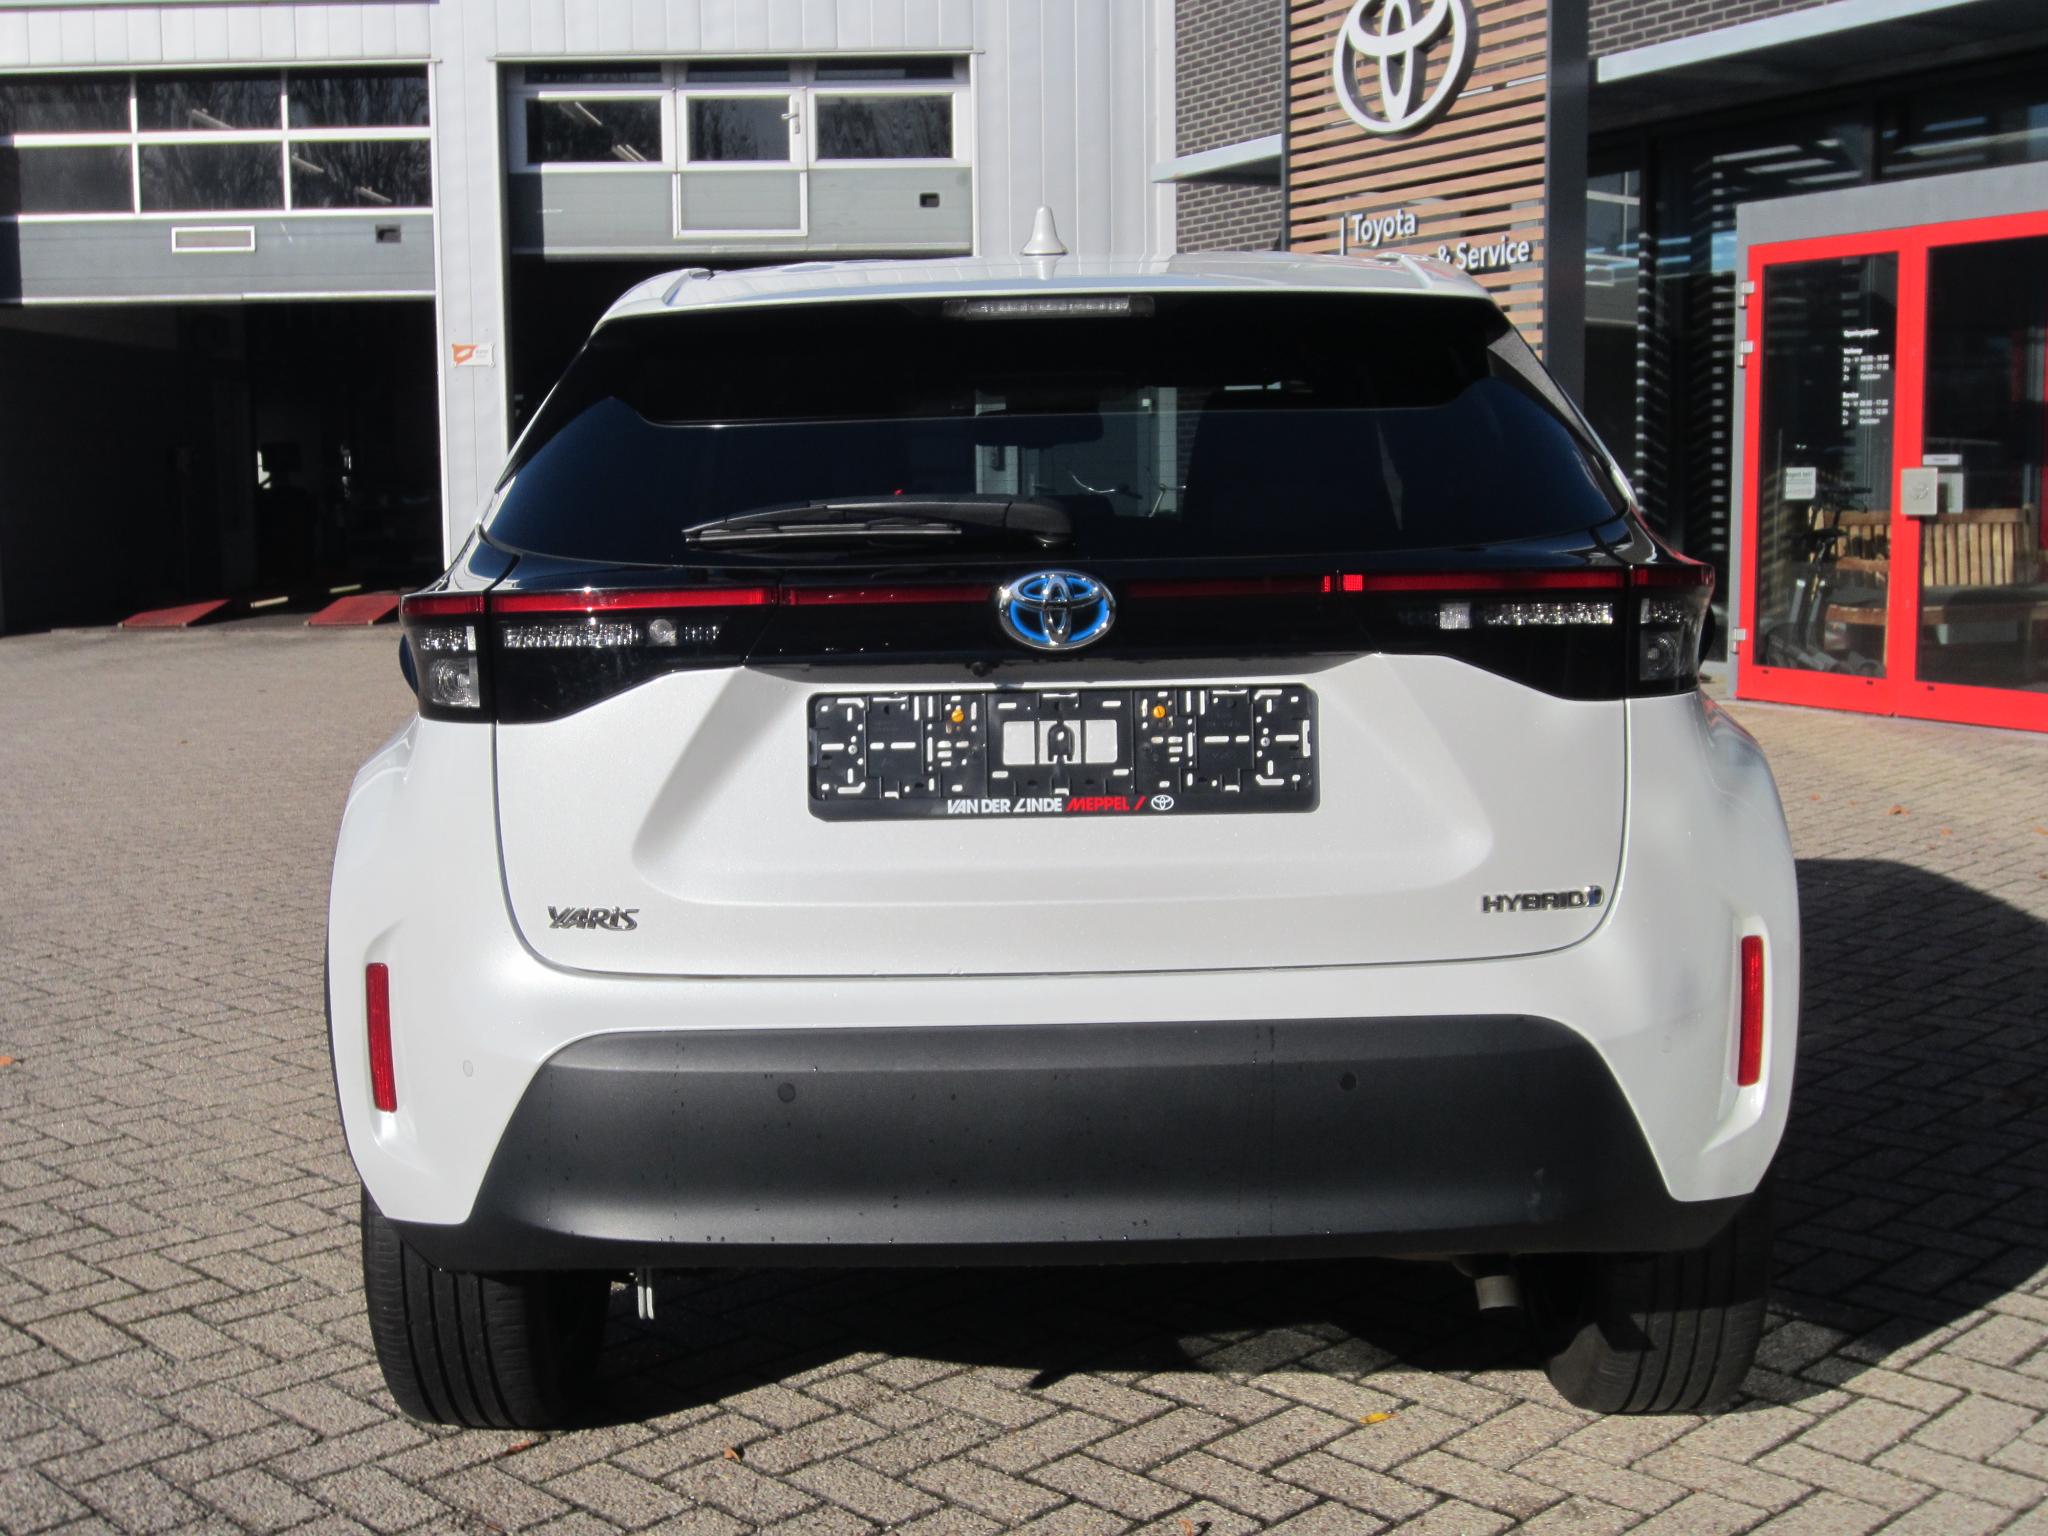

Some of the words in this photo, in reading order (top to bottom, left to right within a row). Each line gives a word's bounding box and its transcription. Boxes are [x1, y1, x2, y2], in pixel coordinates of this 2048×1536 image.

[1352, 209, 1416, 247] Toyota
[1437, 245, 1452, 263] &
[1456, 235, 1530, 270] Service
[948, 799, 978, 814] VAN
[981, 799, 1010, 814] DER
[1013, 798, 1062, 813] LINDE
[1066, 797, 1130, 812] MEPPEL
[1482, 890, 1586, 913] HYBRID
[547, 905, 640, 931] YARIS
